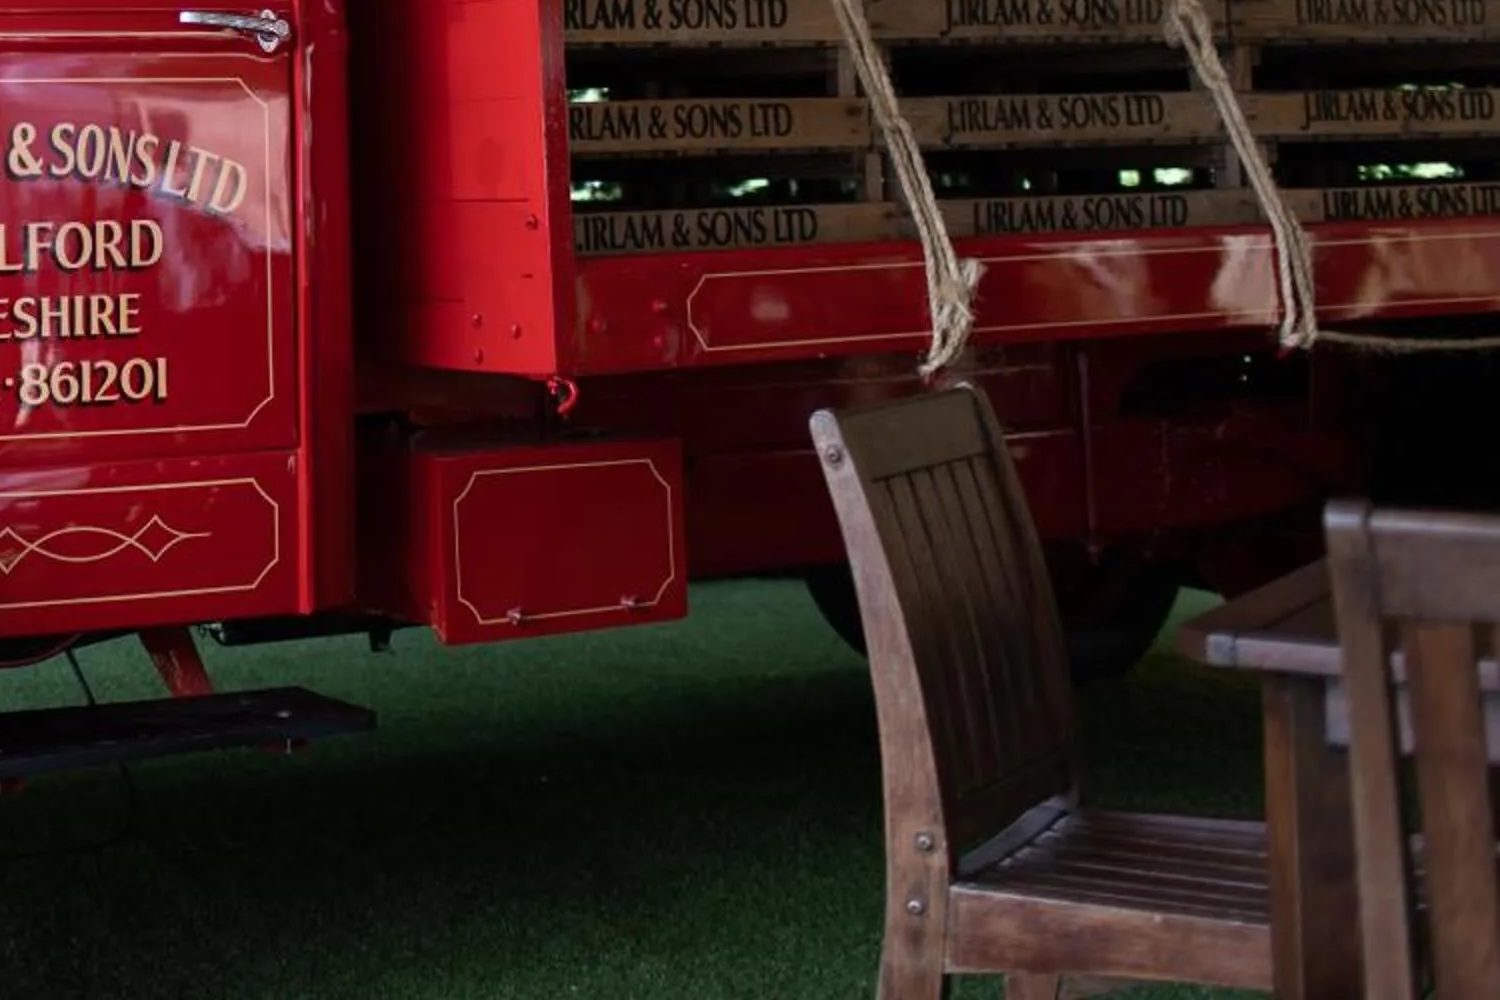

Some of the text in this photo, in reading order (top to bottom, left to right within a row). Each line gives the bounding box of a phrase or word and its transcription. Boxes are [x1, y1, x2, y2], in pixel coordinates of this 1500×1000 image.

[569, 103, 793, 141] RLAM & SONS LTD
[1037, 99, 1054, 130] &
[1059, 96, 1121, 130] SONS
[1125, 96, 1165, 126] LTD
[1383, 92, 1397, 121] &
[1402, 91, 1455, 122] SONS
[1460, 91, 1494, 120] LTD
[8, 122, 44, 177] &
[50, 123, 159, 189] SONS
[159, 141, 248, 214] LTD
[1061, 198, 1077, 231] &
[1082, 196, 1143, 227] SONS
[1150, 196, 1188, 226] LTD
[1398, 188, 1414, 218] &
[1416, 186, 1468, 216] SONS
[577, 208, 819, 252] .IRLAM & SONS LTD
